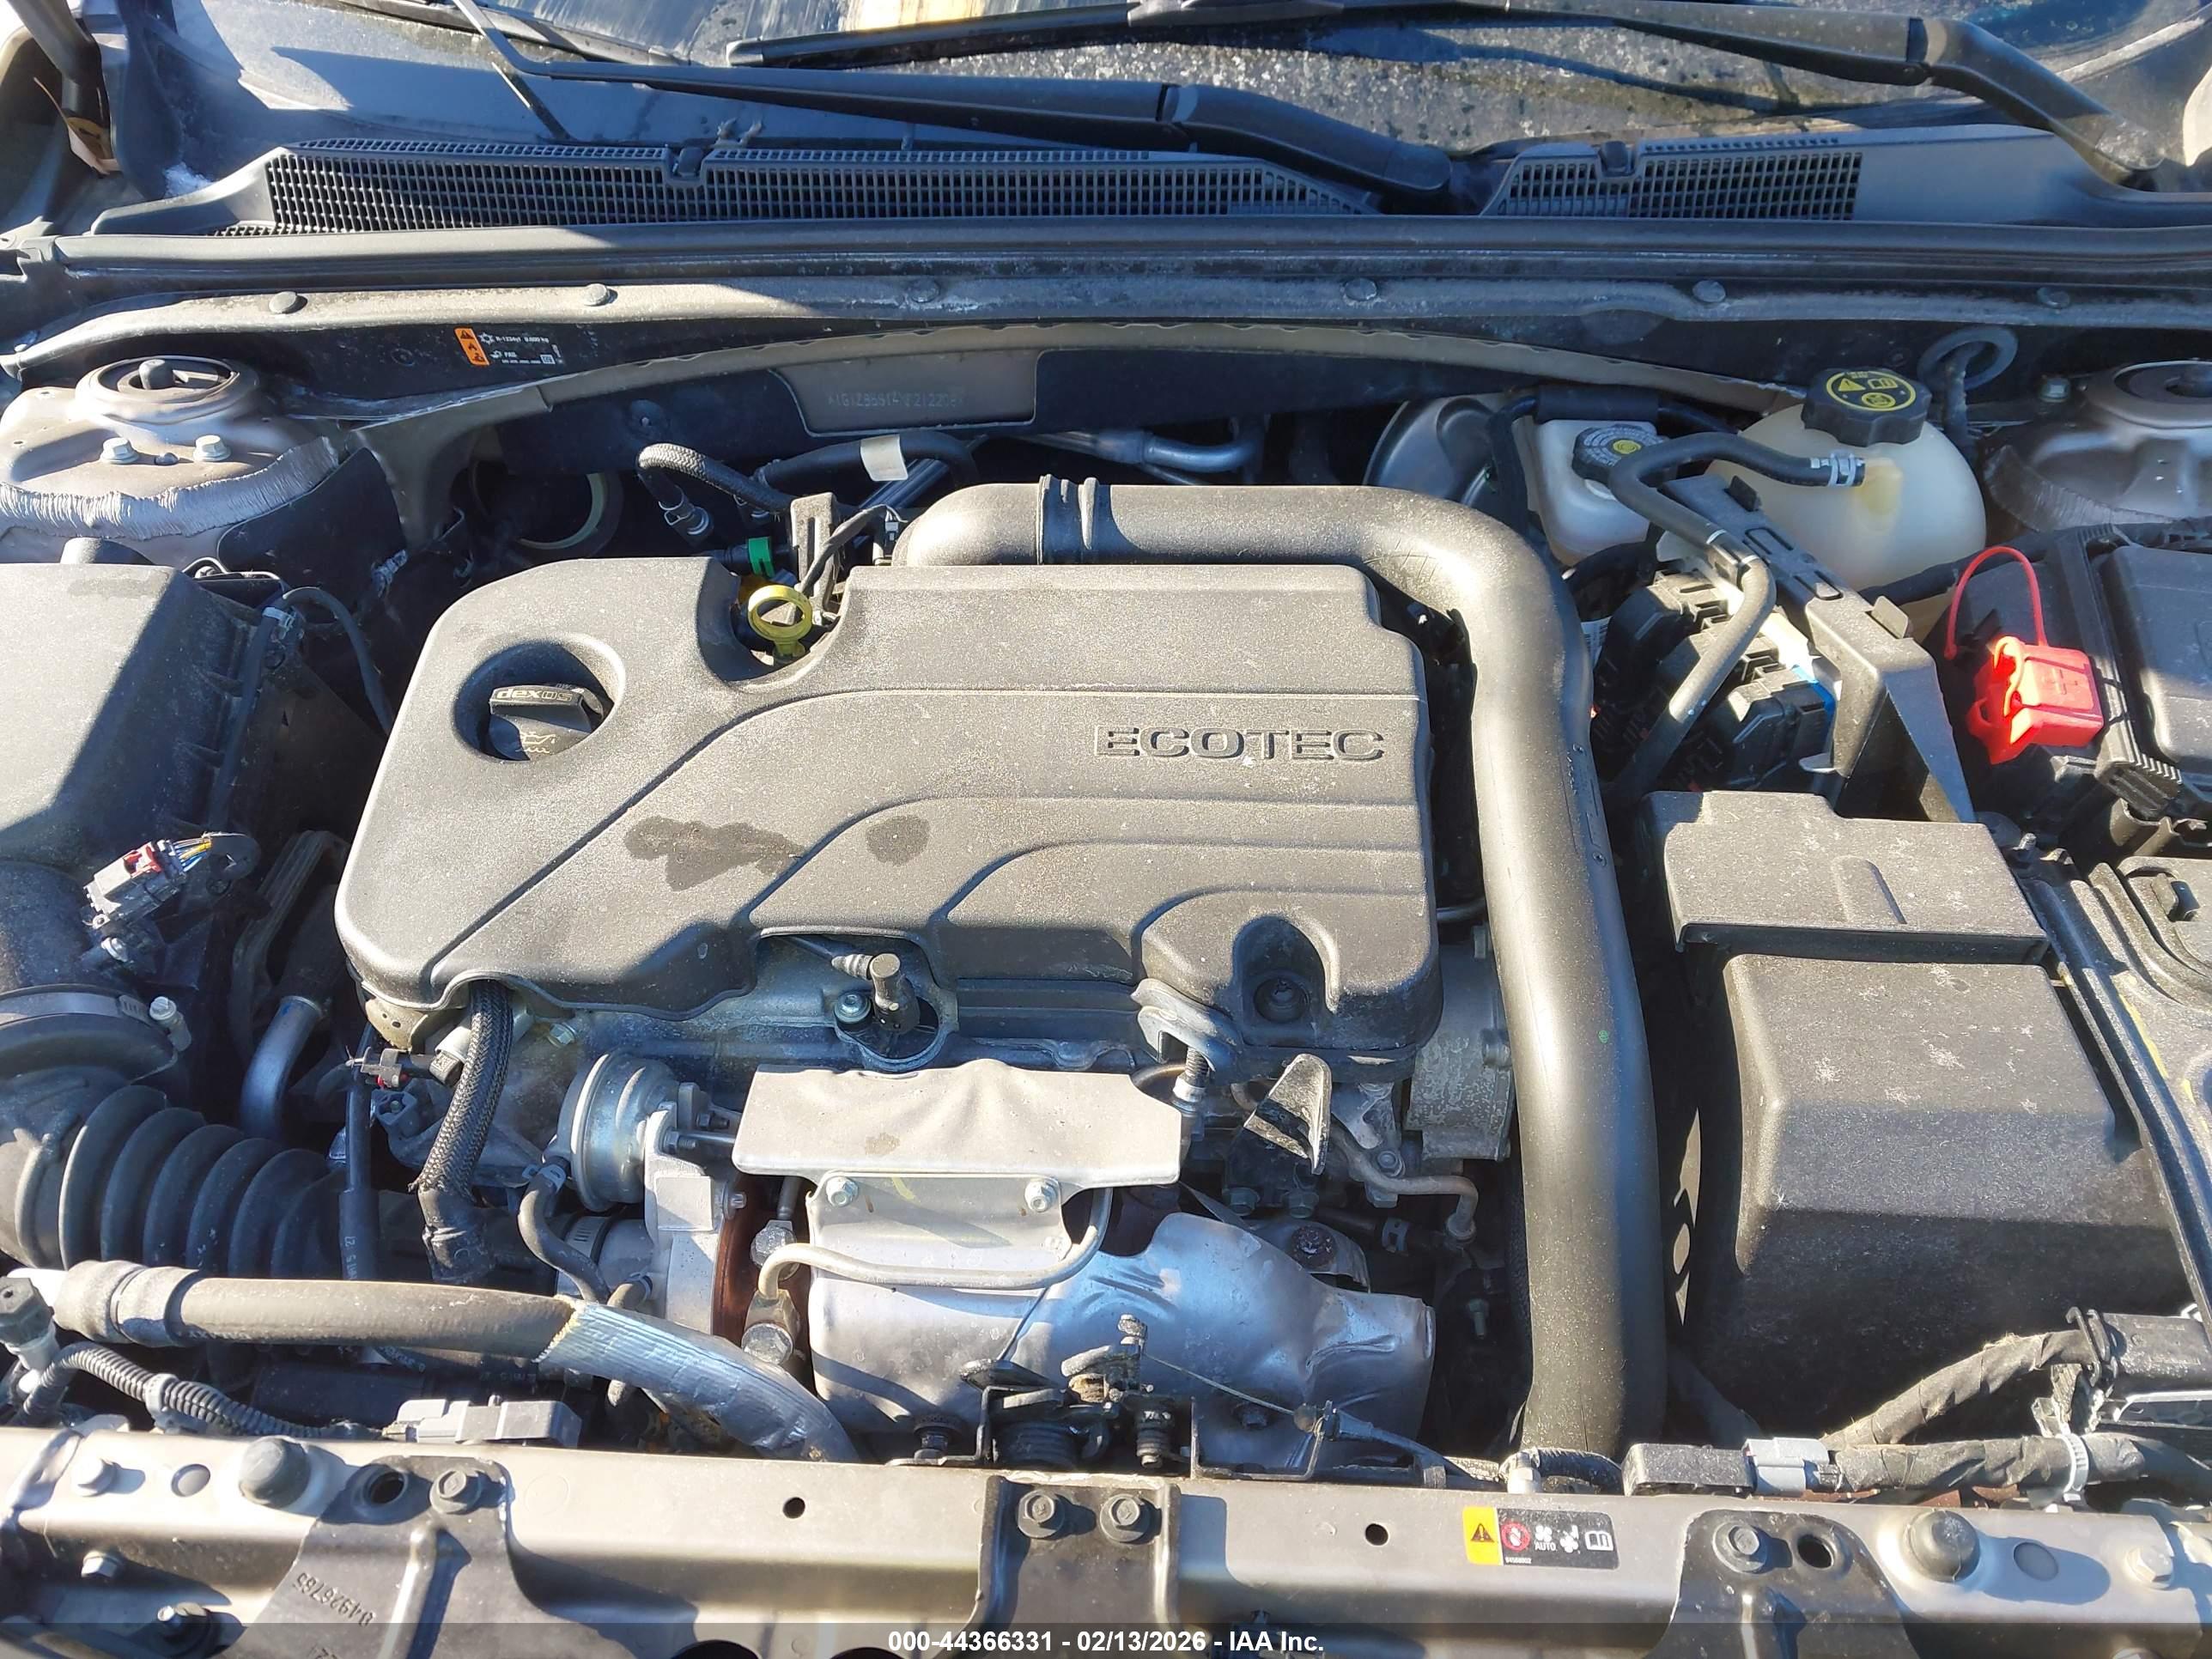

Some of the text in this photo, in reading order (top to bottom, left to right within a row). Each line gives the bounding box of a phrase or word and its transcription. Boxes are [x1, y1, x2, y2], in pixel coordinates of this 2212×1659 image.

[496, 688, 574, 702] dexos
[1094, 725, 1385, 762] ECOTEC
[1534, 1542, 1556, 1552] AUTO
